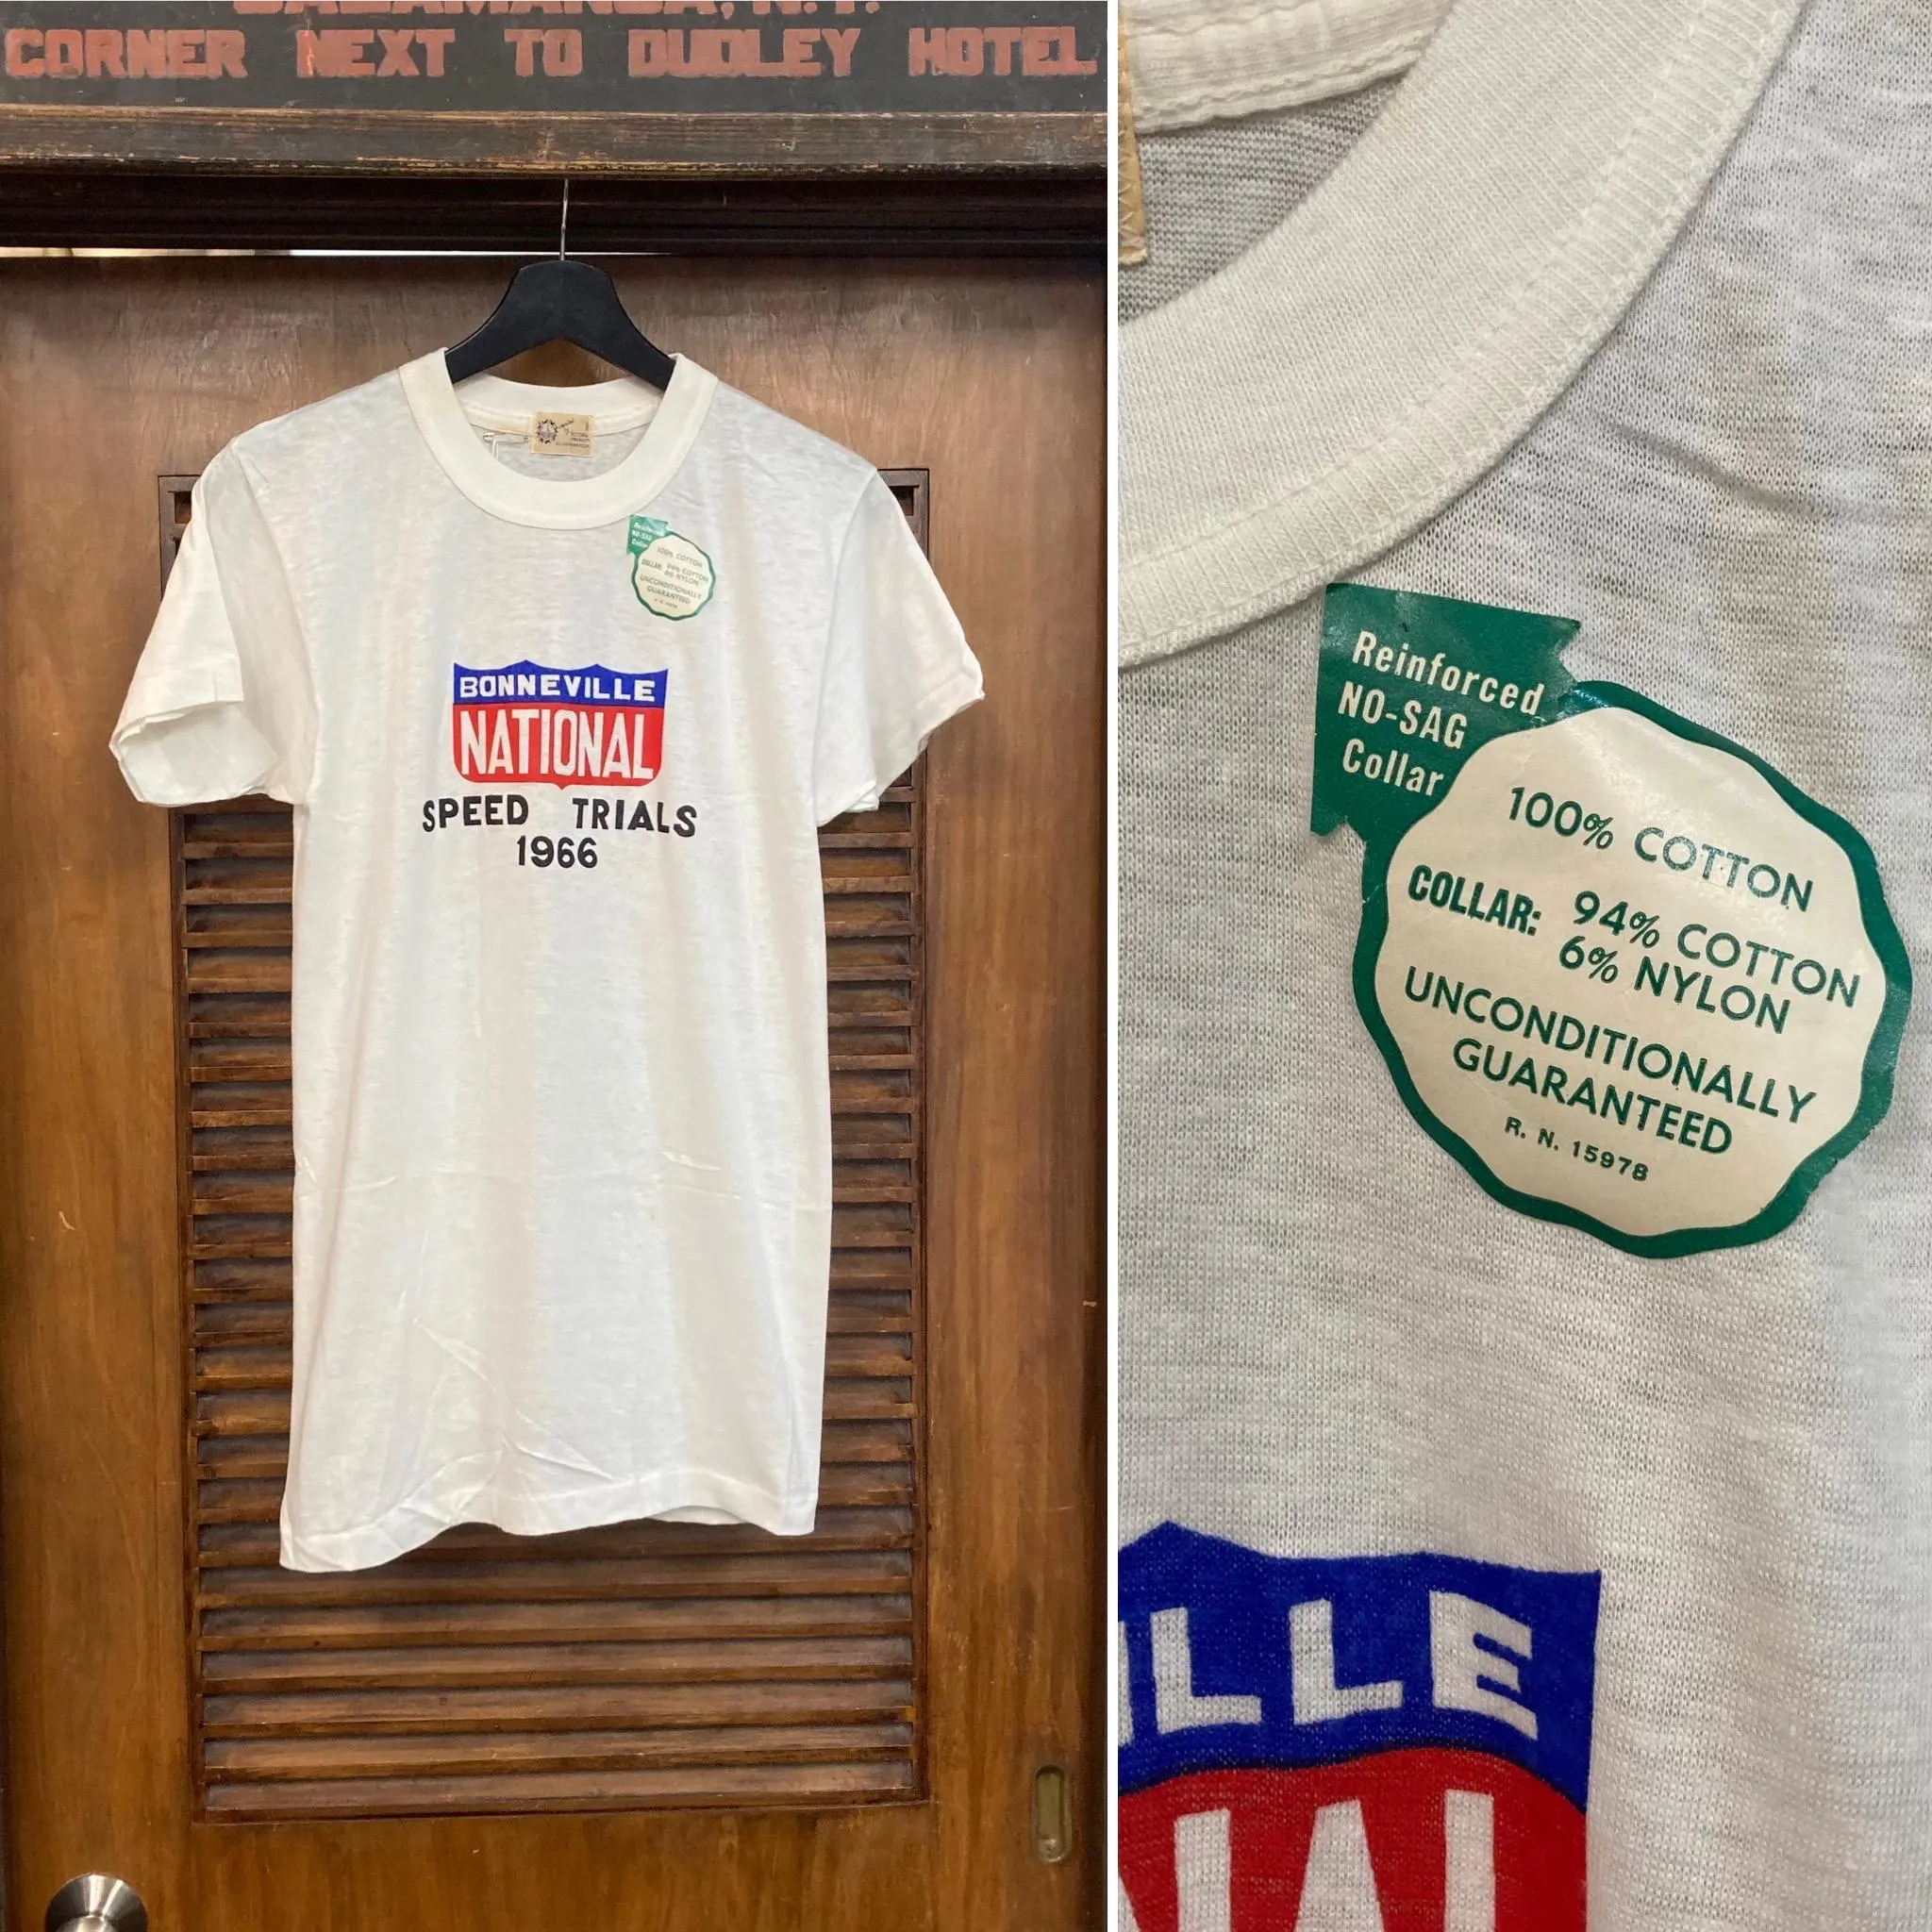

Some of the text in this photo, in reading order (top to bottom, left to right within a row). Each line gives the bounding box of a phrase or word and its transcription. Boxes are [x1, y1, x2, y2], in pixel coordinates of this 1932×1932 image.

[6, 26, 1098, 78] CORNER NEXT TO DUDLEY HOTEL
[676, 554, 703, 567] COTTON
[682, 568, 708, 582] COTTON
[459, 675, 656, 702] BONNEVILLE
[1352, 630, 1545, 716] Reinforced
[459, 709, 655, 780] NATIONAL
[1338, 680, 1468, 751] NO-SAG
[1341, 738, 1444, 798] Collar
[422, 794, 698, 838] SPEED TRIALS
[1508, 787, 1814, 912] 100% COTTON
[516, 835, 599, 869] 1966
[1407, 864, 1861, 1008] COLLAR: 94% COTTON
[1558, 936, 1792, 1035] 6% NYLON
[1404, 966, 1817, 1124] UNCONDITIONALLY
[1452, 1037, 1733, 1157] GUARANTEED
[1505, 1115, 1650, 1182] R. N. 15978
